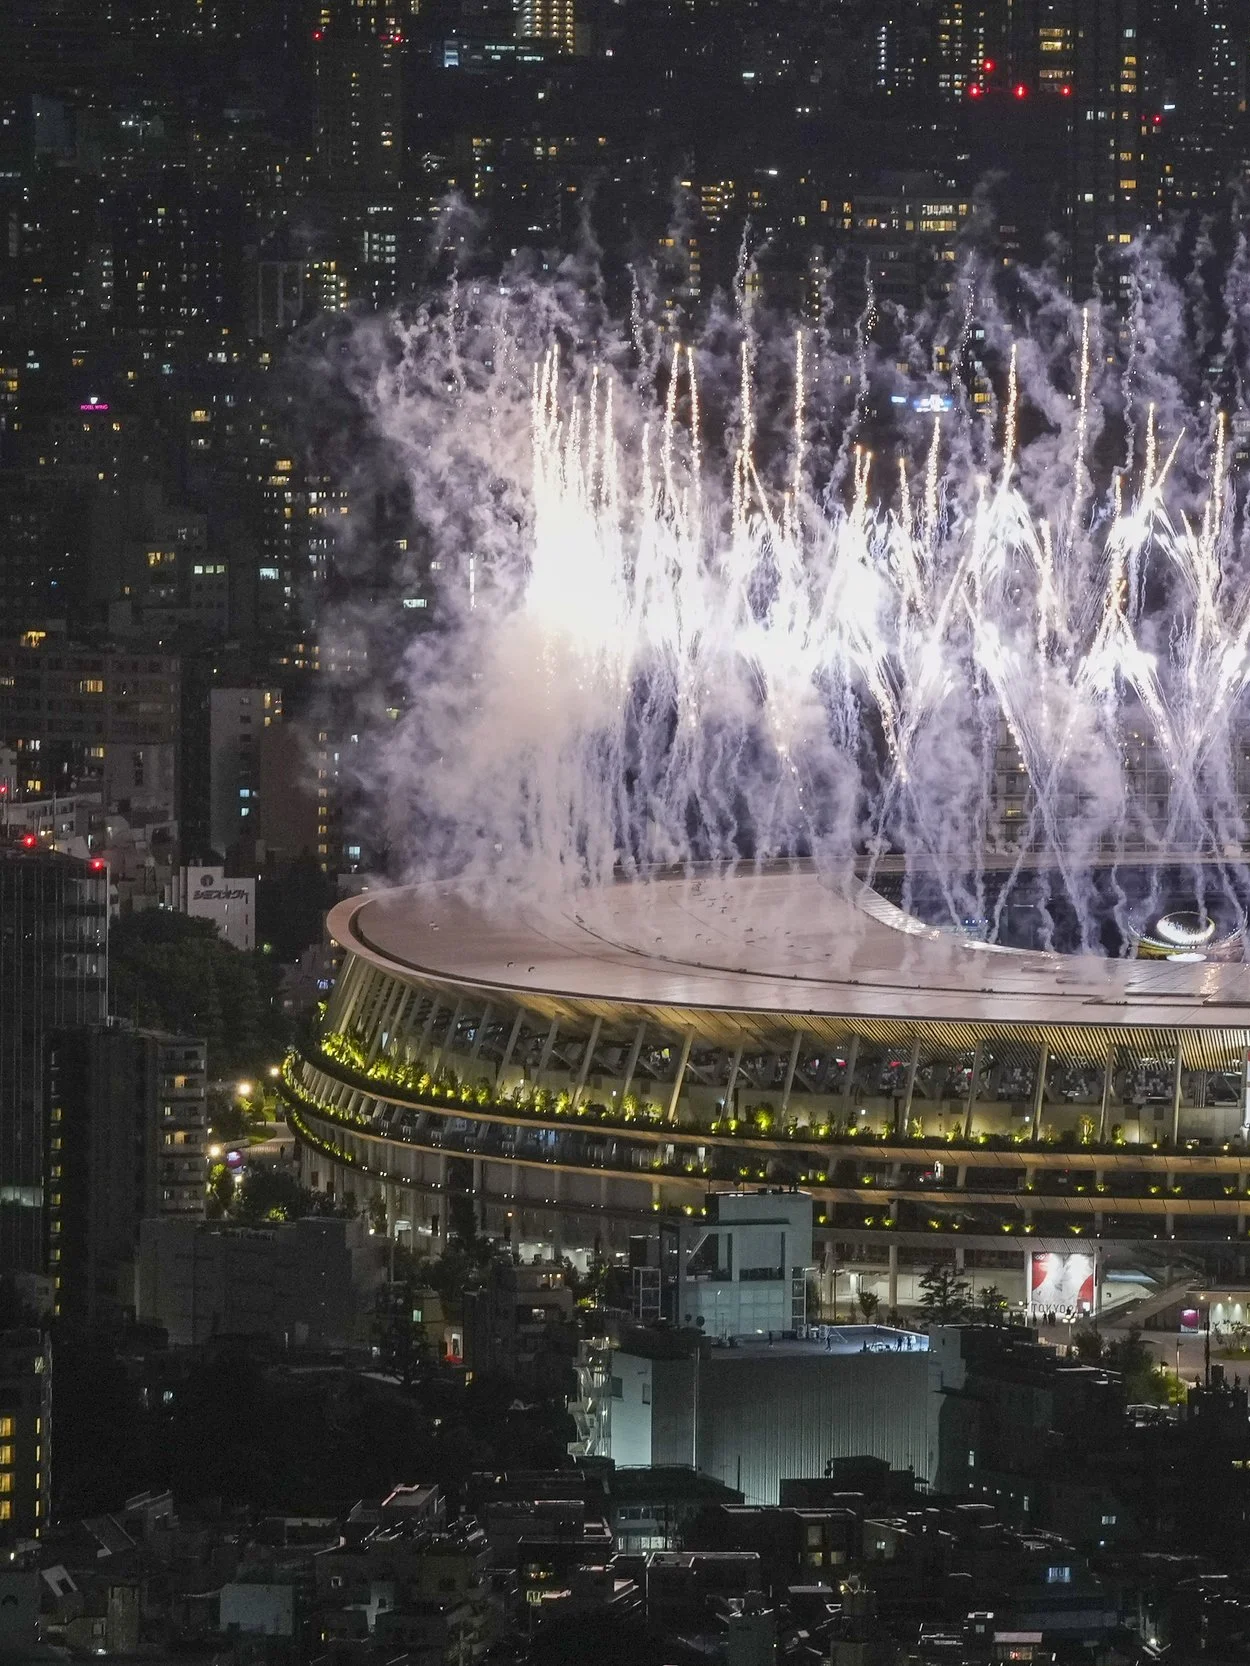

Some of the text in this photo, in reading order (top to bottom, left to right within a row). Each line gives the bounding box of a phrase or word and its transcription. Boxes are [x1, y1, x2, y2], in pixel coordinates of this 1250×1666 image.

[193, 888, 249, 901] シミズオクト
[1031, 1303, 1066, 1314] TOKYO
